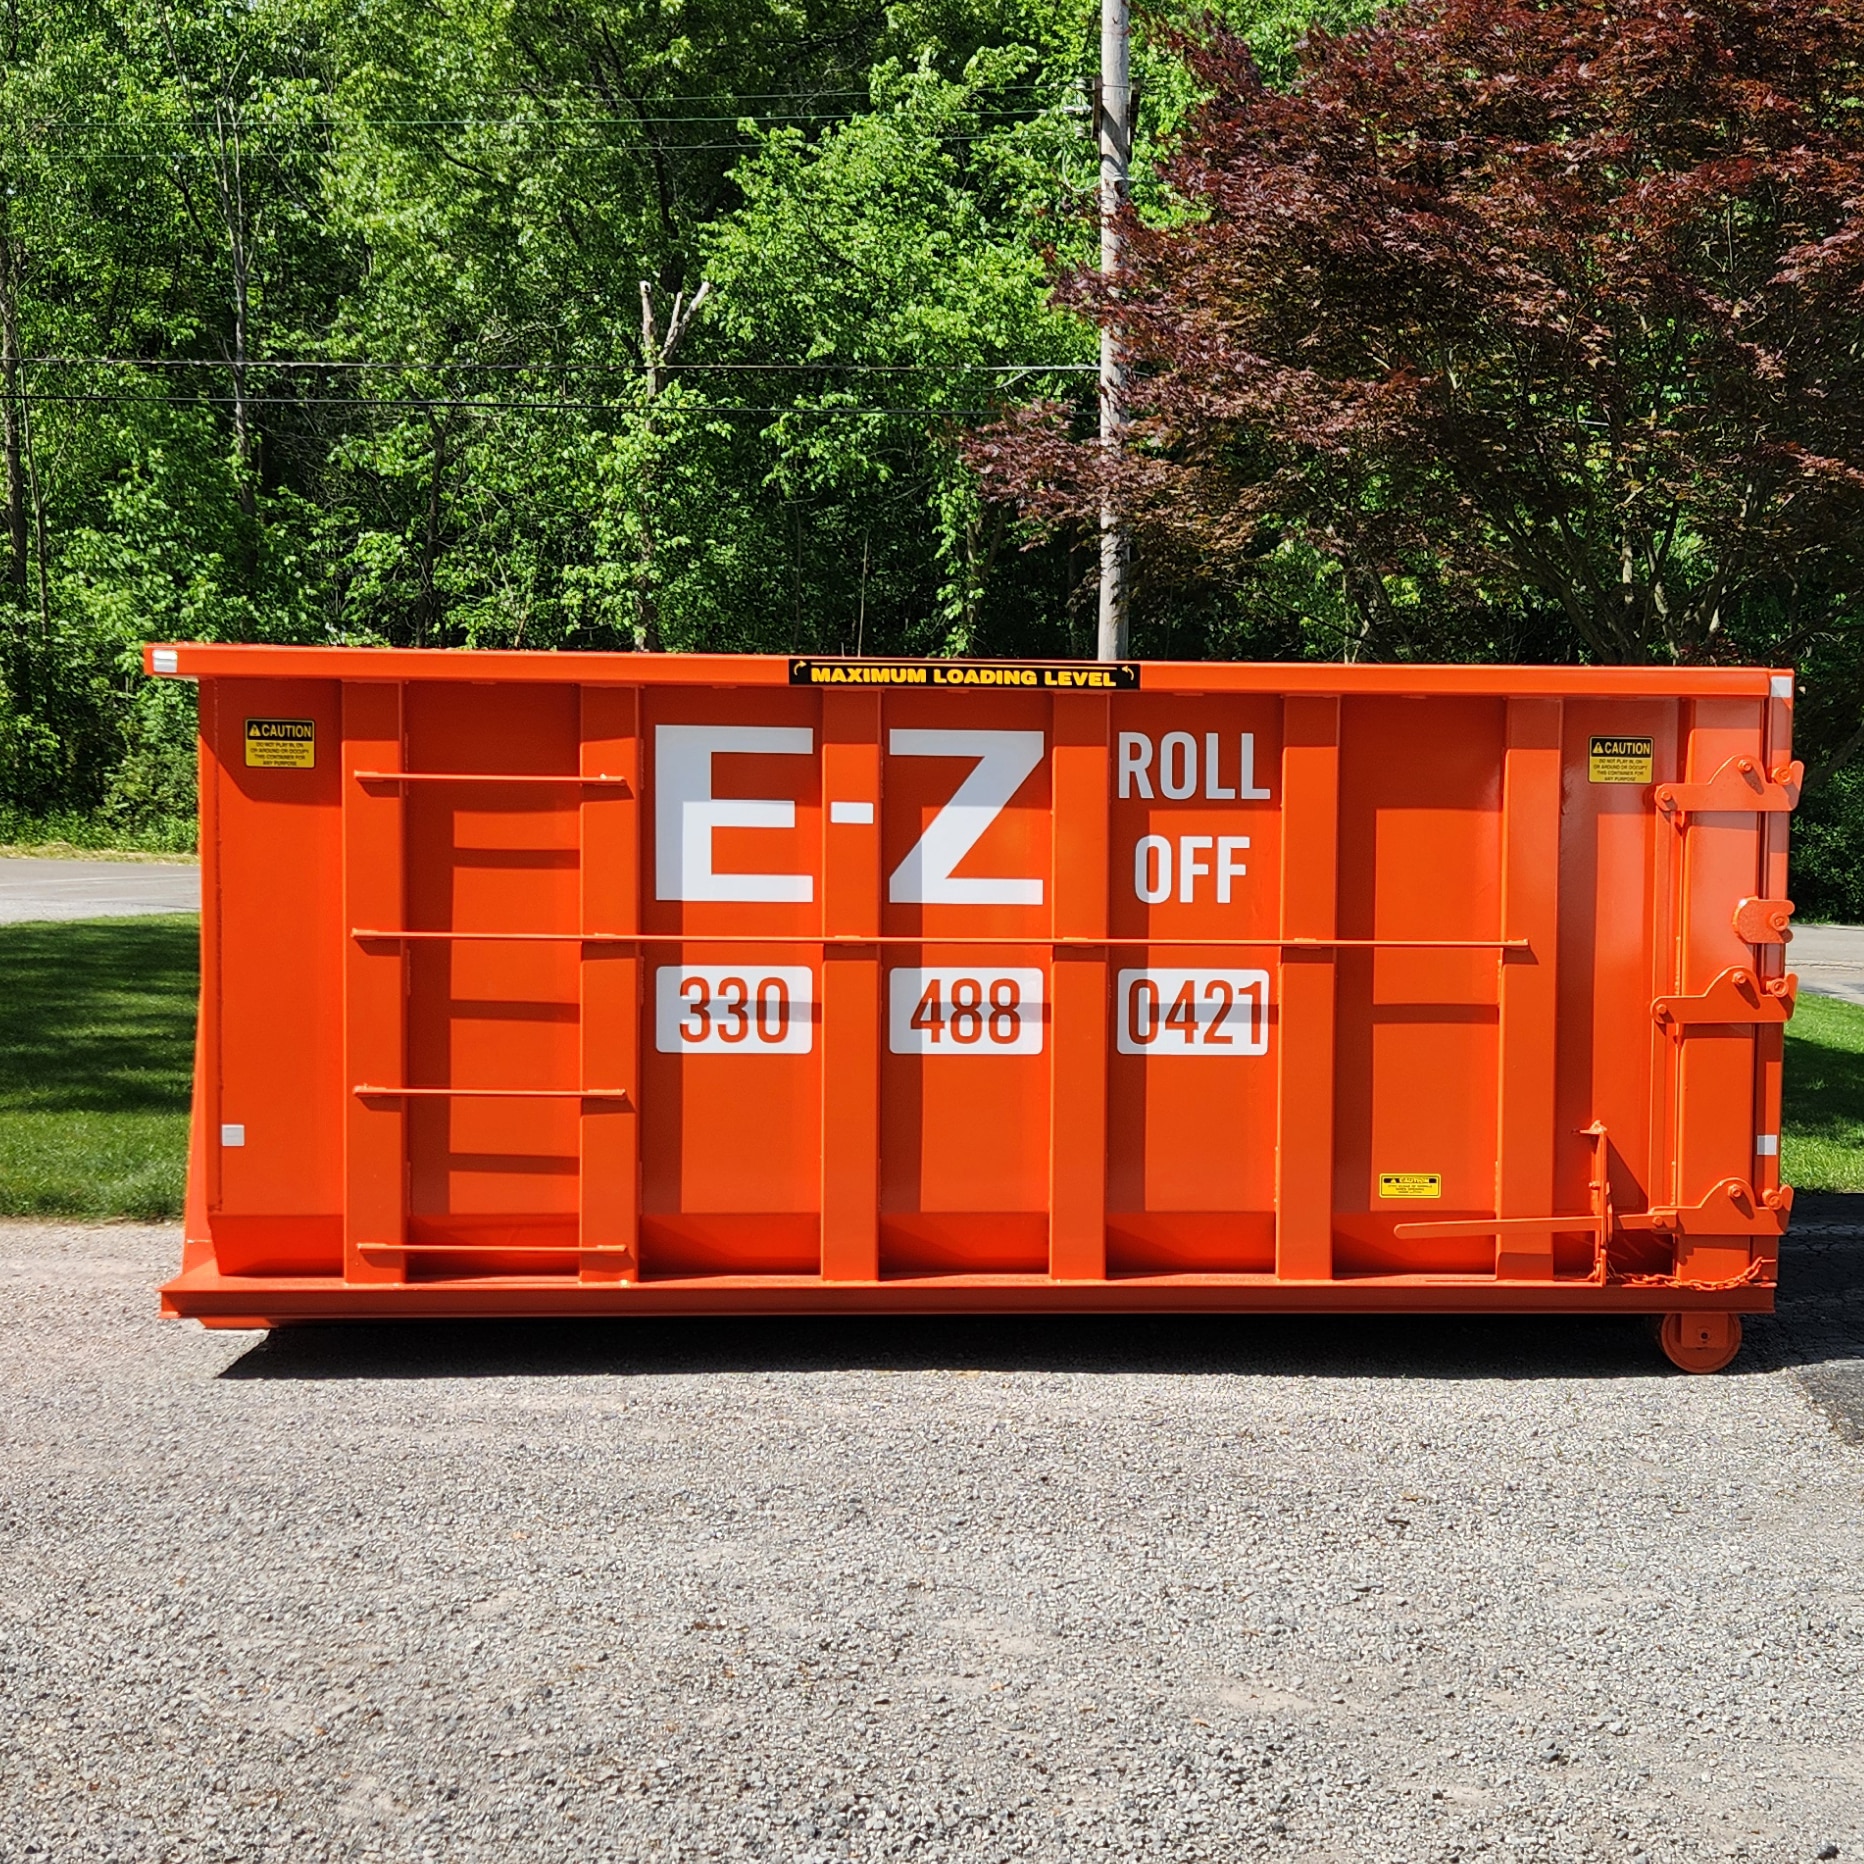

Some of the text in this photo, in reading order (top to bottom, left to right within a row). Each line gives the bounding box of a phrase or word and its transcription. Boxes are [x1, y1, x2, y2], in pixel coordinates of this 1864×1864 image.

[811, 667, 1116, 687] MAXIMUM LOADING LEVEL
[262, 724, 311, 737] CAUTION
[1605, 742, 1650, 754] CAUTION
[1118, 731, 1271, 800] ROLL
[1135, 835, 1251, 904] OFF
[679, 977, 1263, 1046] 330 488 0421
